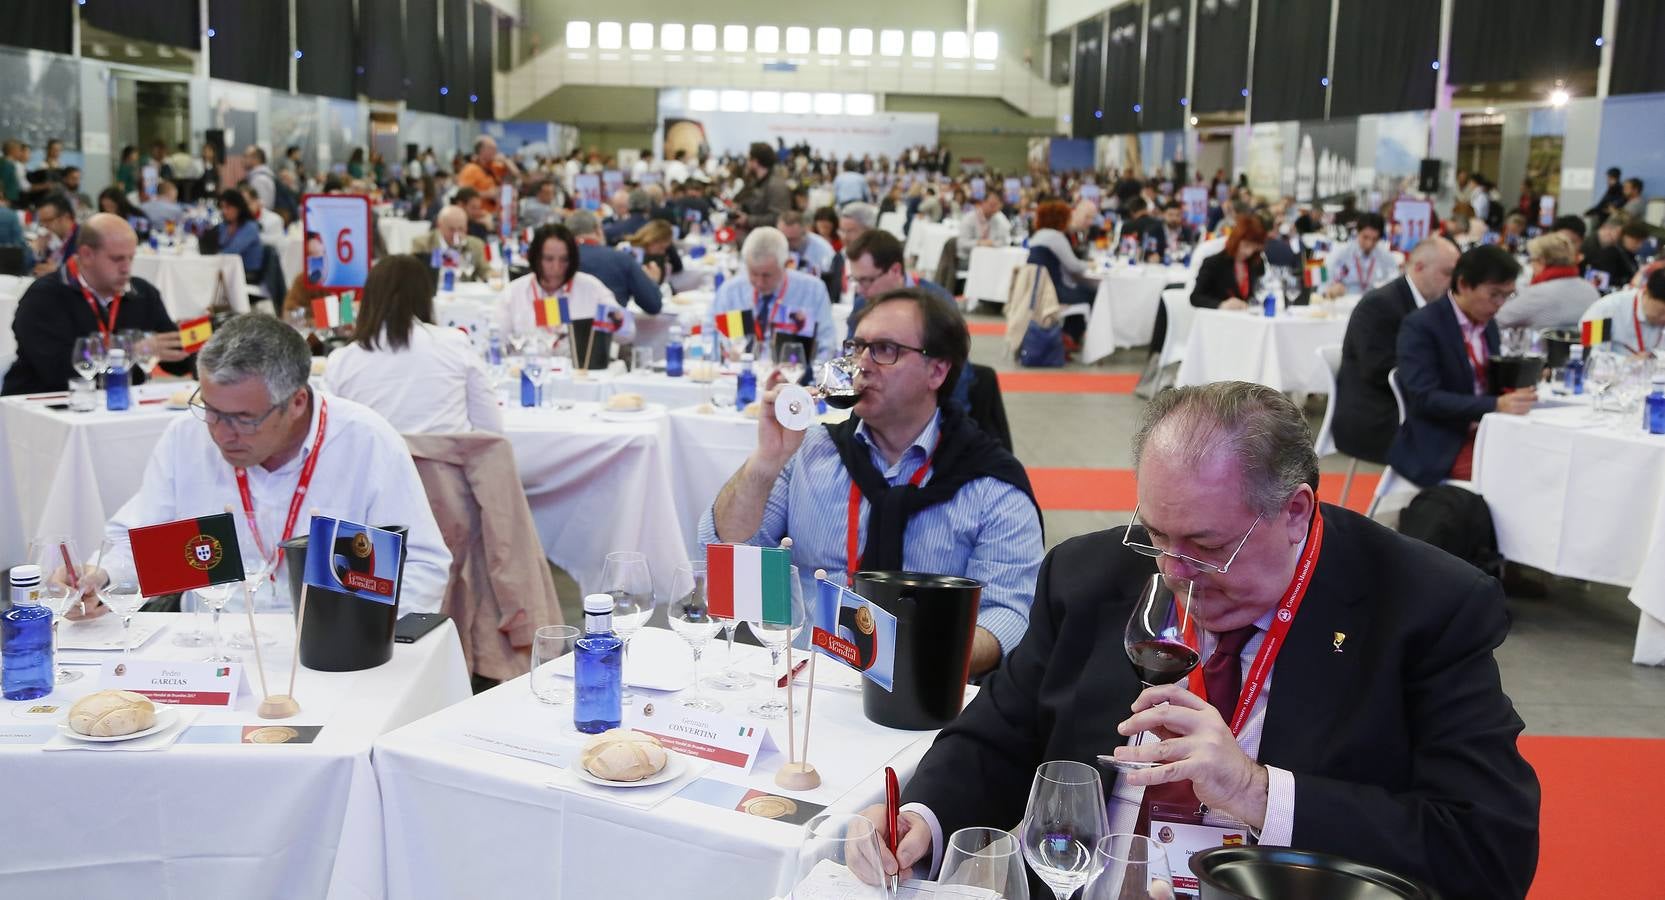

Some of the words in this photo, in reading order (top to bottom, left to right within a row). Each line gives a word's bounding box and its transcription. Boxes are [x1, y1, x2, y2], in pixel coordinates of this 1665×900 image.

[1408, 219, 1424, 238] 11
[336, 228, 353, 265] 6
[1286, 582, 1302, 608] Concours
[1298, 560, 1312, 583] Mondial
[829, 636, 856, 654] Concours
[829, 643, 857, 661] Mondial
[1232, 706, 1246, 734] Concours
[1244, 681, 1258, 706] Mondial
[668, 724, 718, 739] CONVERTINI
